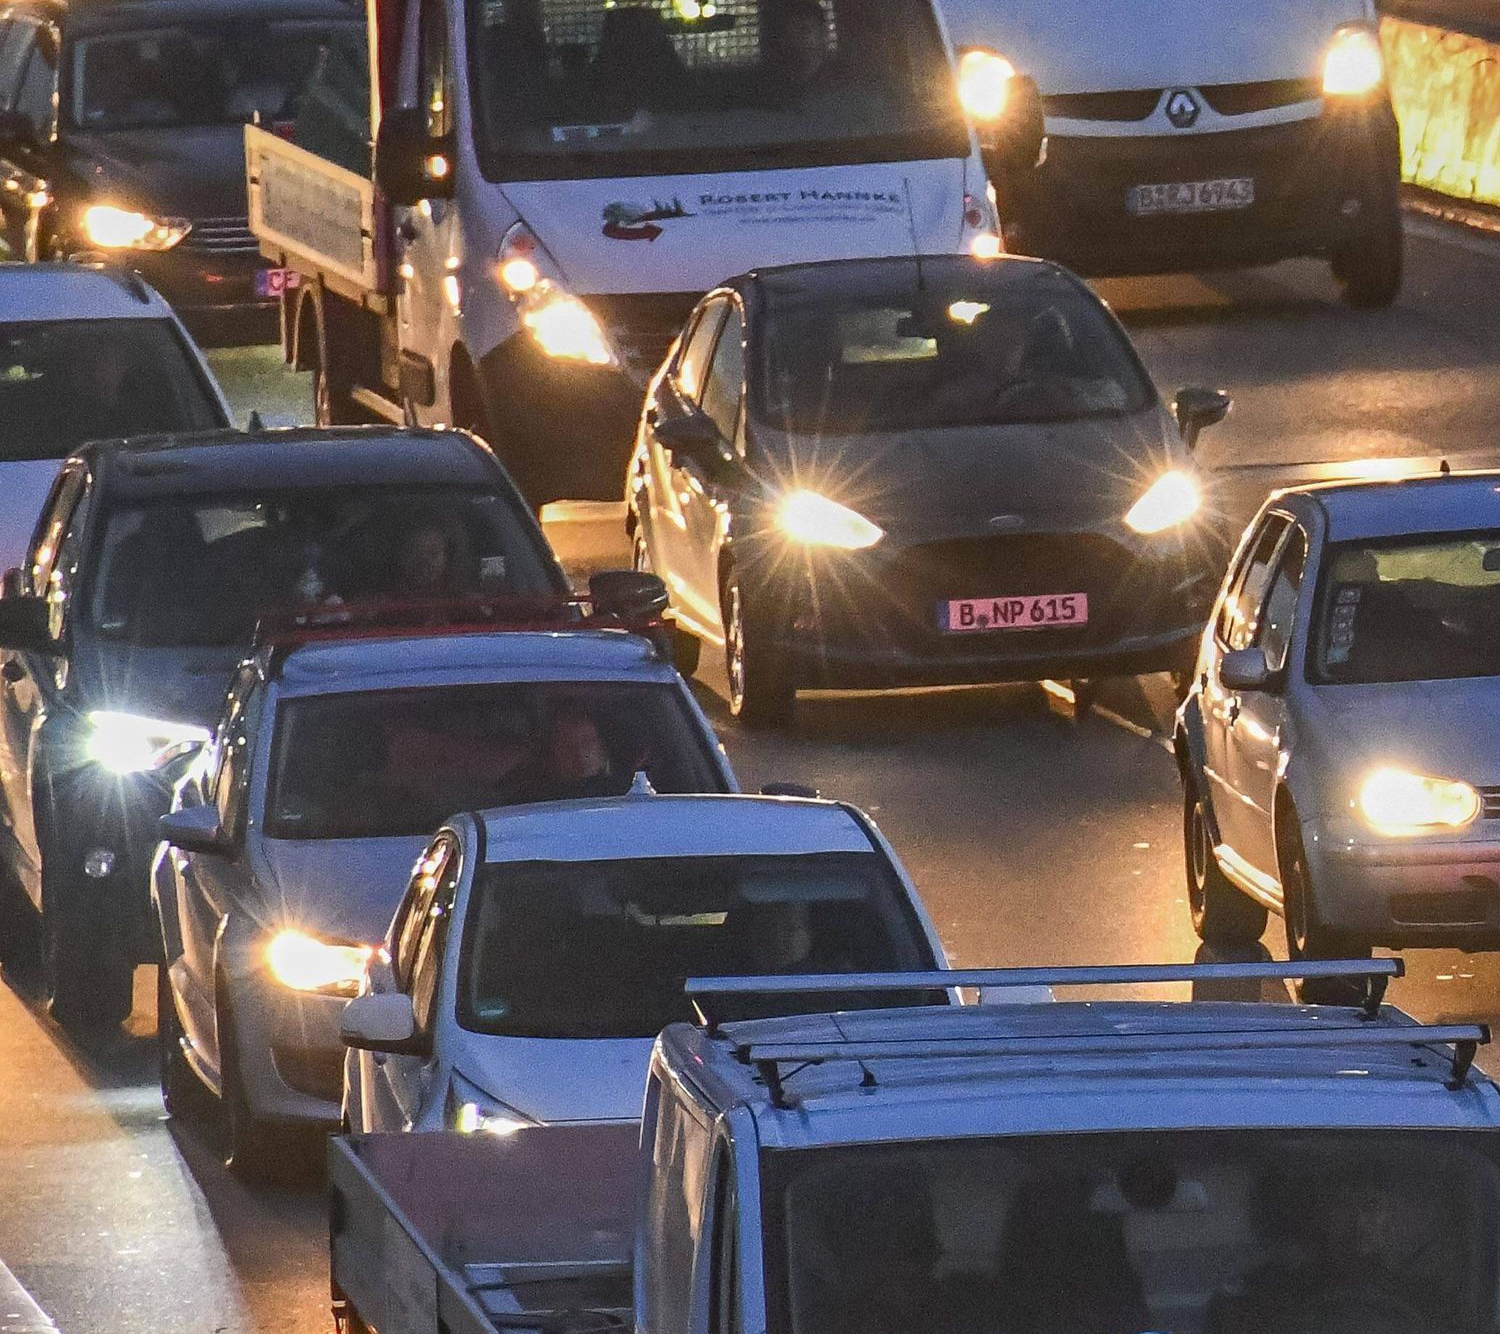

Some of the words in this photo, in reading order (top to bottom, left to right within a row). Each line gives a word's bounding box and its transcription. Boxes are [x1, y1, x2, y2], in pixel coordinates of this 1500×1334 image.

[960, 603, 975, 627] B
[993, 601, 1024, 624] NP
[1030, 597, 1076, 622] 615
